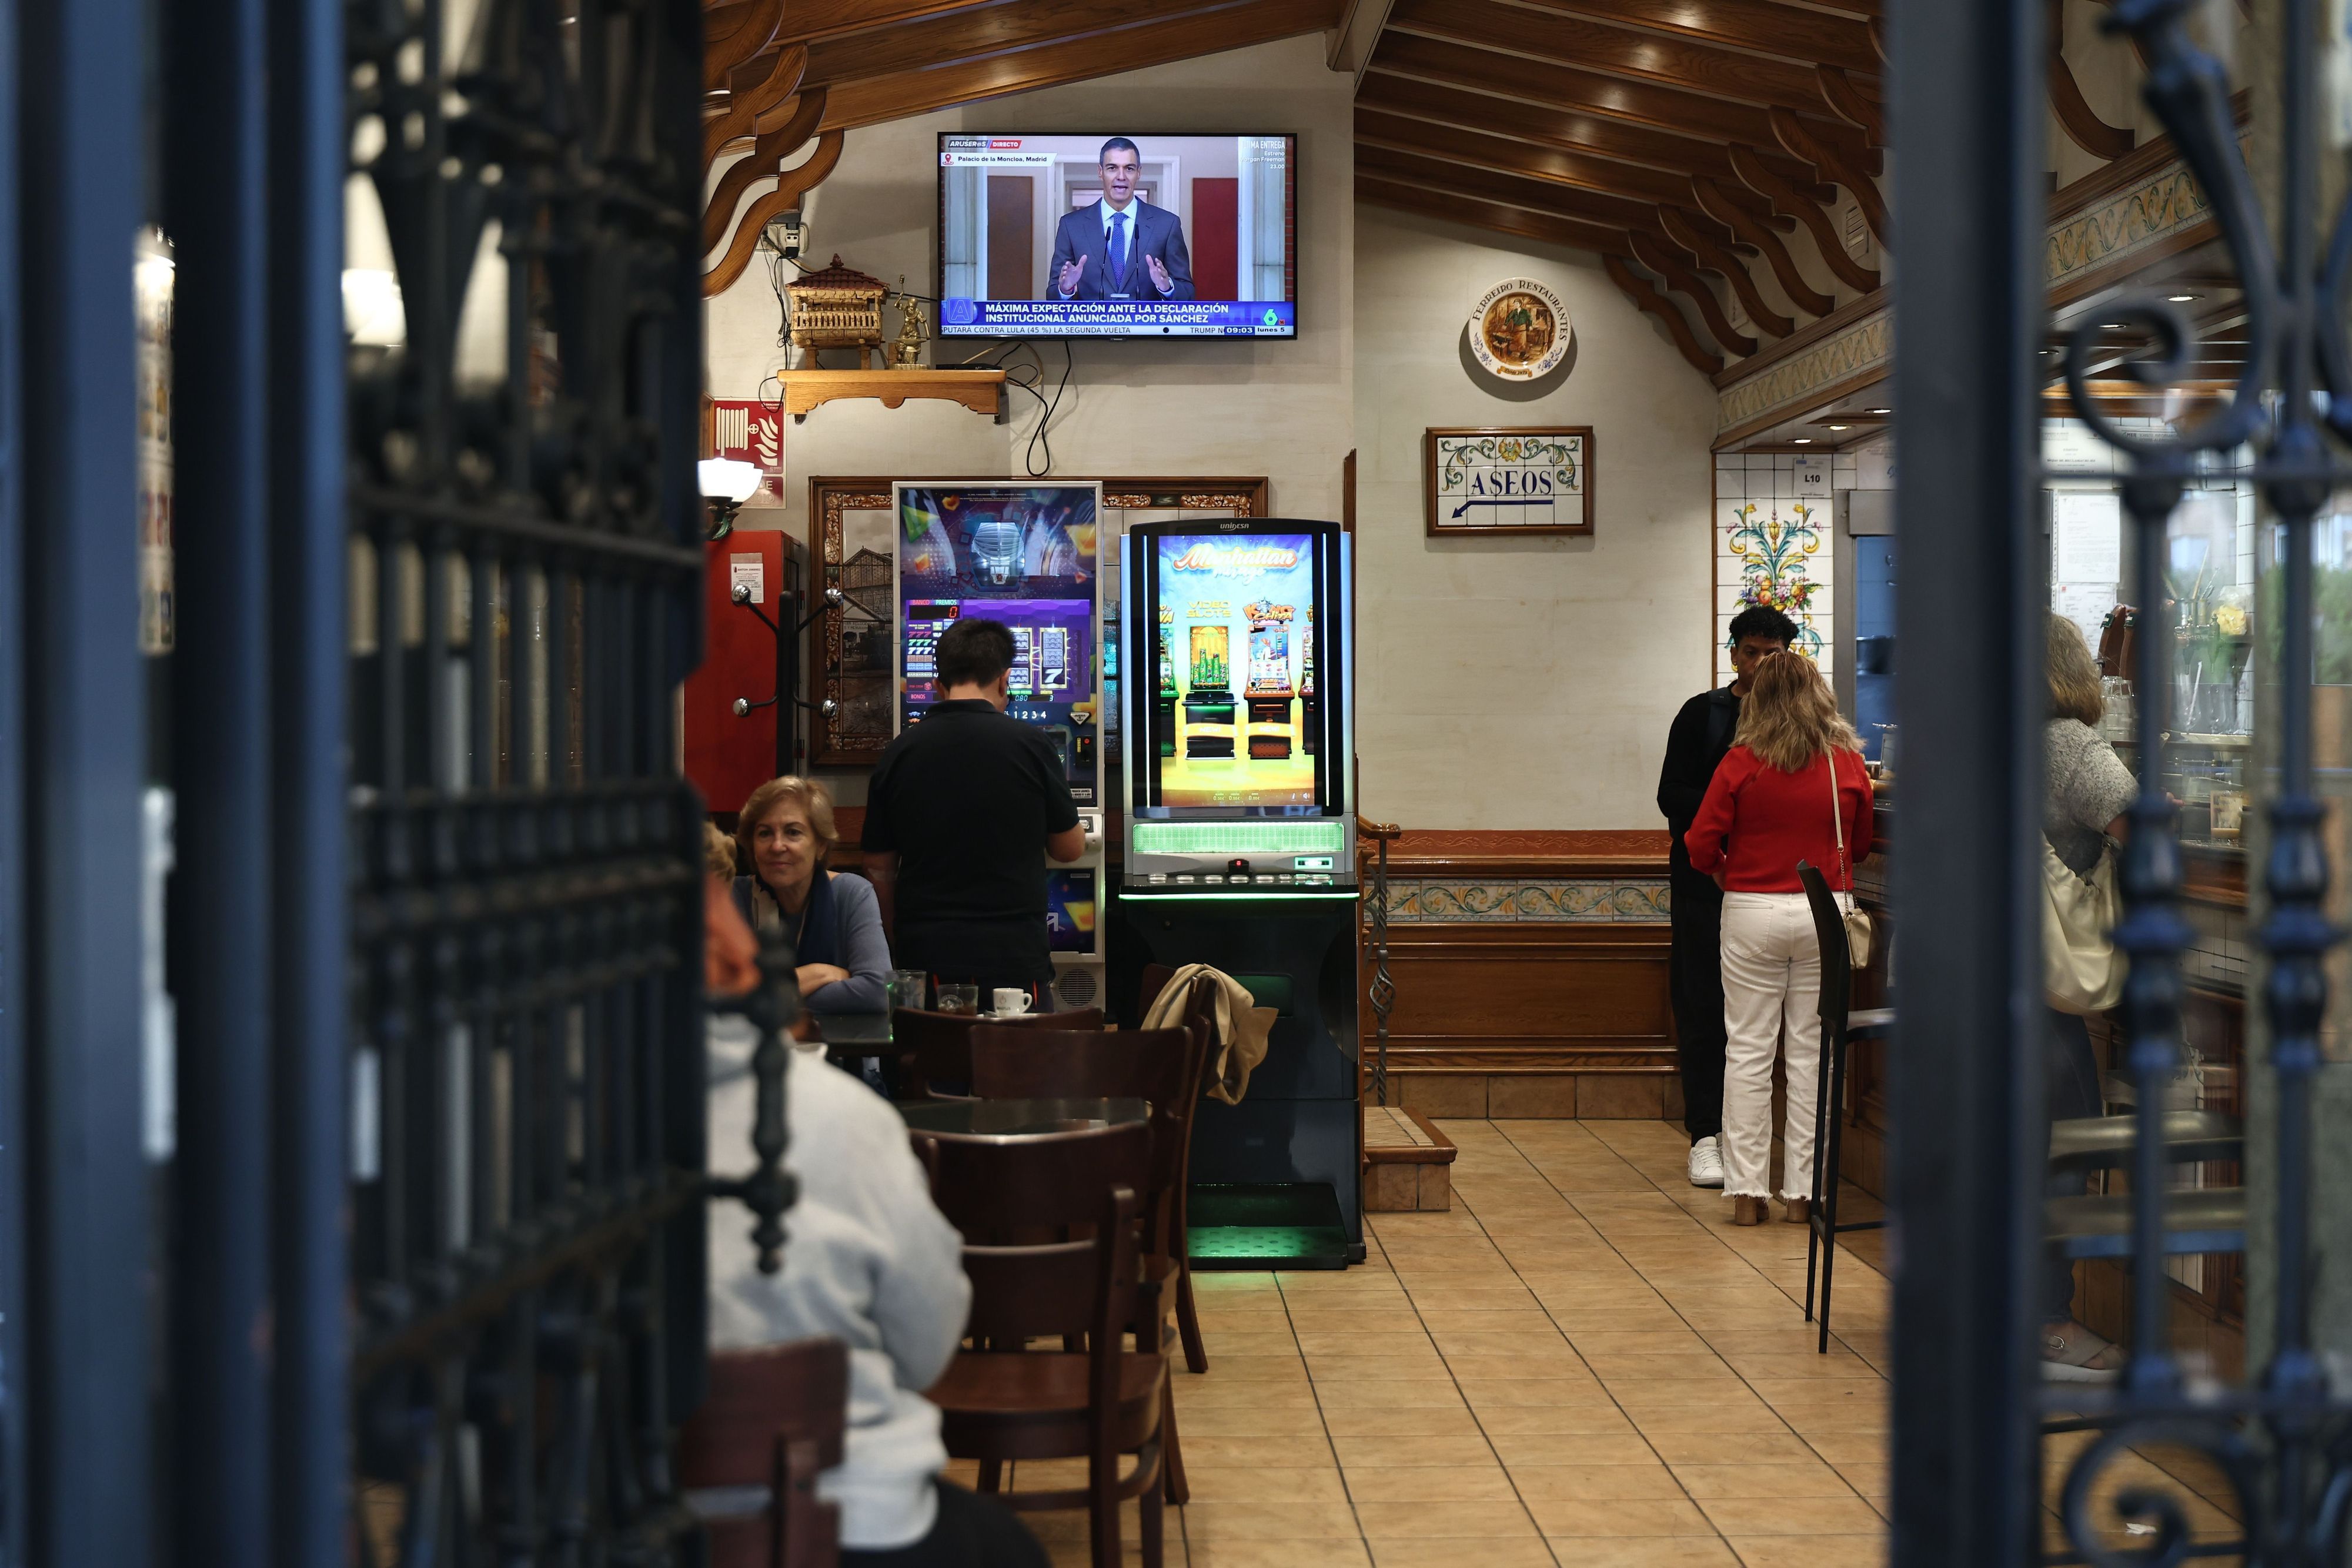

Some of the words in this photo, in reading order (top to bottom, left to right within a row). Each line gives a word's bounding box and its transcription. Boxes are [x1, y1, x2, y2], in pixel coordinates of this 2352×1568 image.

[985, 303, 1029, 313] MÁXIMA
[1032, 303, 1105, 313] EXPECTACIÓN
[1108, 305, 1135, 313] ANTE
[1138, 305, 1152, 313] LA
[1154, 303, 1229, 313] DECLARACIÓN
[1472, 283, 1513, 321] FERREIRO
[1519, 280, 1569, 341] RESTAURANTES
[985, 314, 1065, 323] INSTITUCIONAL
[1068, 314, 1132, 323] ANUNCIADA
[1135, 315, 1157, 323] POR
[1159, 312, 1208, 323] SÁNCHEZ
[1471, 470, 1552, 495] ASEOS
[1805, 474, 1820, 483] L10
[1175, 544, 1295, 569] Manhattan
[1188, 600, 1231, 609] VIDEO
[949, 607, 957, 618] 0
[1186, 609, 1231, 618] SLOTS
[1243, 602, 1295, 621] KNG
[1044, 668, 1063, 683] 7
[1014, 711, 1018, 719] 1
[1023, 711, 1028, 719] 2
[1031, 711, 1037, 719] 3
